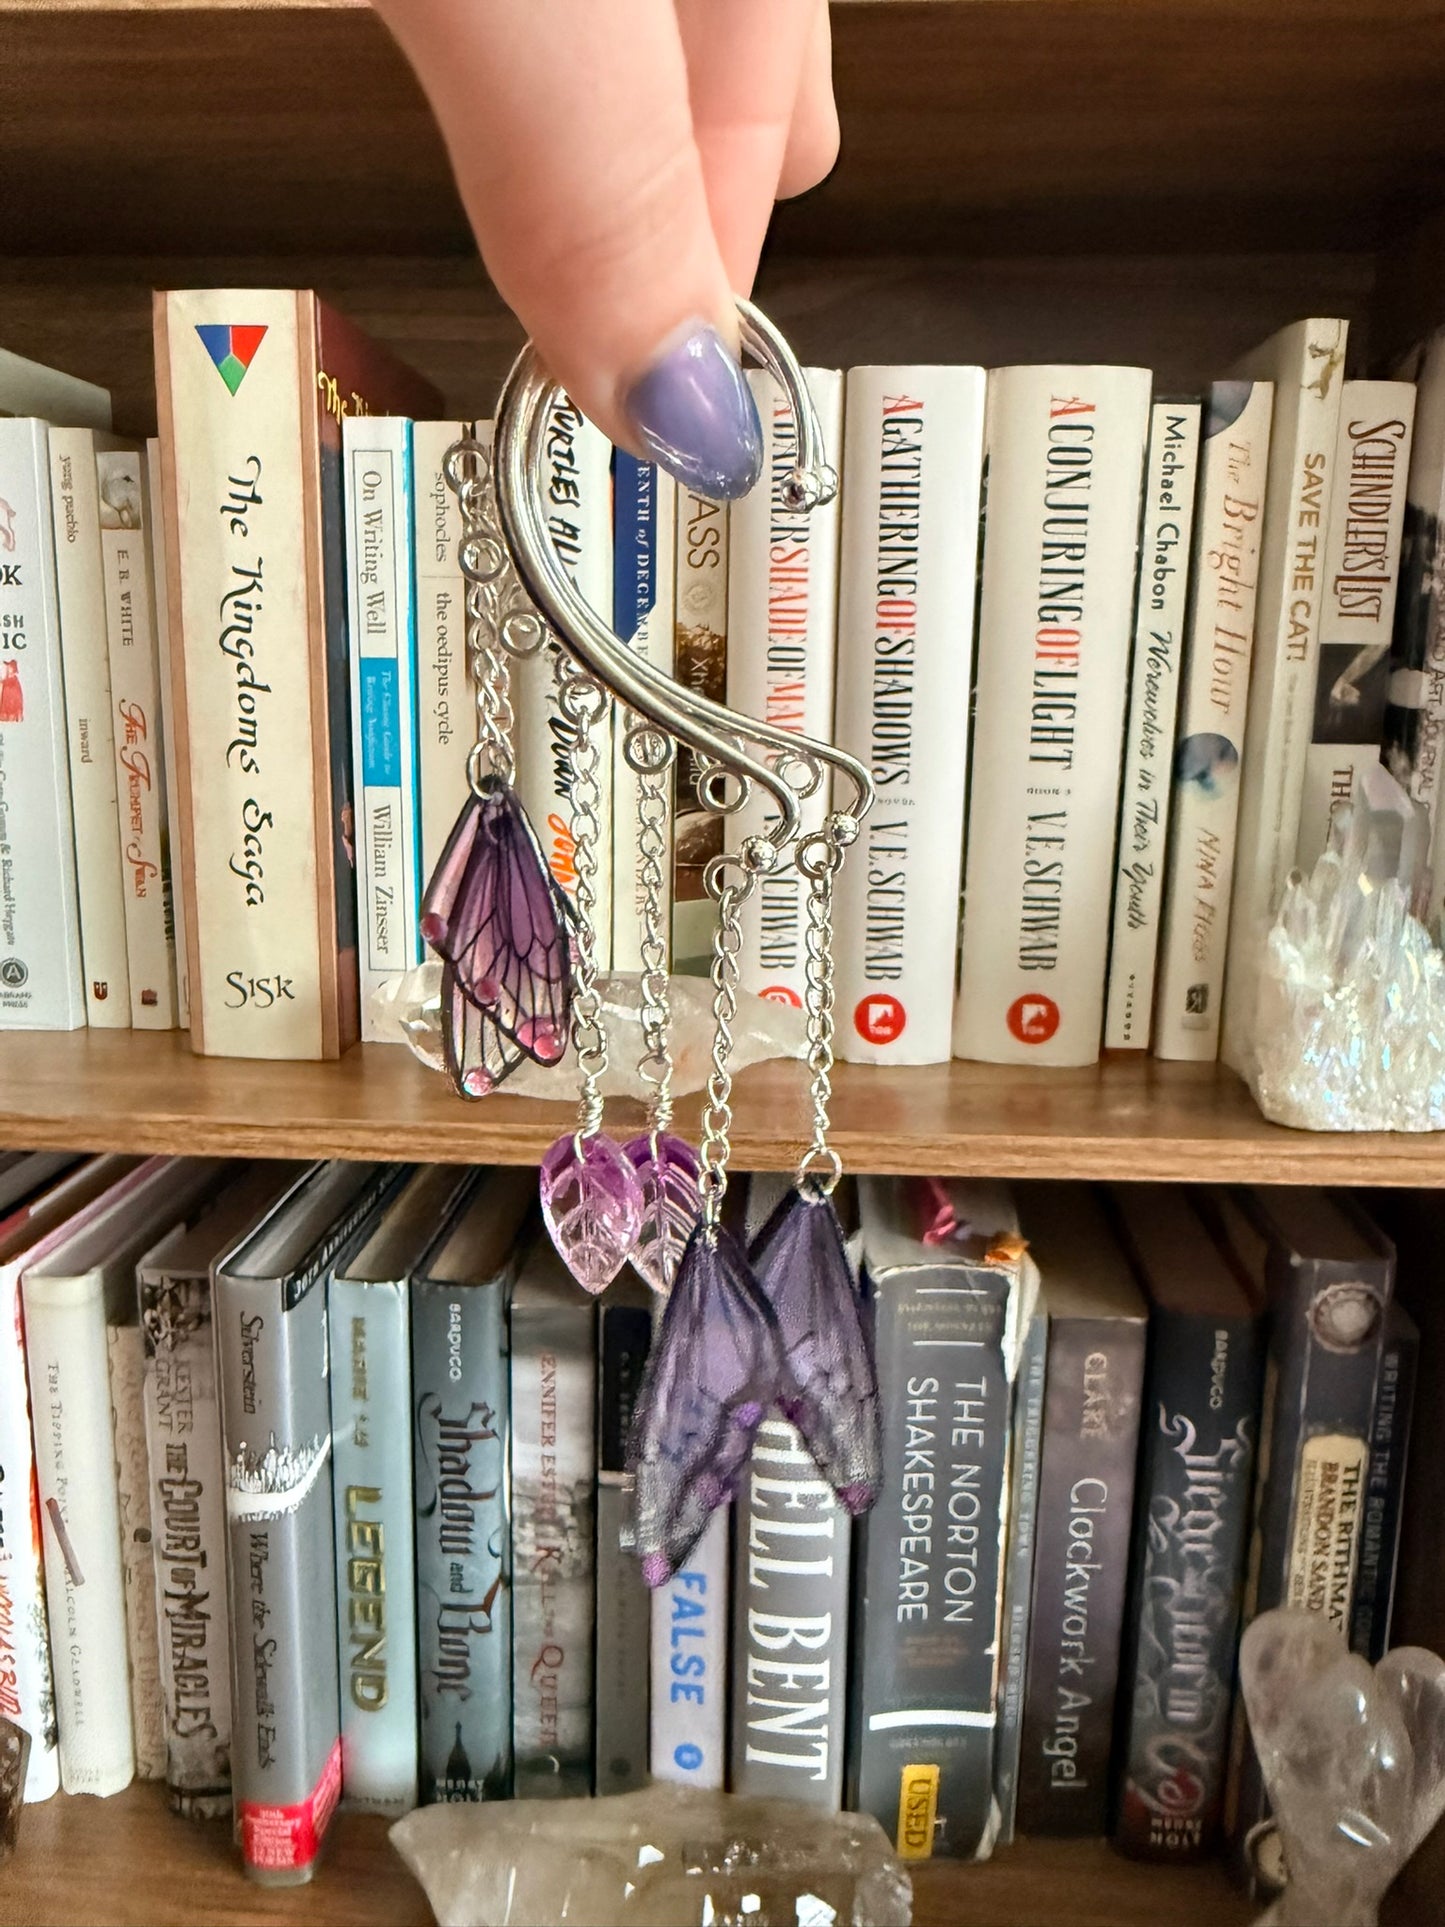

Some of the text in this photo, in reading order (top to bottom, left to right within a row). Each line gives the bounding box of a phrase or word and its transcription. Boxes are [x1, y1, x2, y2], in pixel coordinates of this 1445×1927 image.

[1049, 394, 1097, 418] A
[430, 472, 450, 563] sophocles
[686, 493, 721, 570] ASS
[1037, 423, 1096, 624] CONJURING
[1151, 415, 1187, 610] Michael Chabon
[1298, 453, 1326, 528] SAVE
[360, 470, 386, 635] On Writing Well
[636, 528, 649, 547] of
[1208, 493, 1259, 613] Bright
[1292, 536, 1317, 592] THE
[119, 592, 134, 647] WHITE
[636, 553, 650, 660] DECEMBE
[871, 394, 924, 786] A GATHERING OF SHADOWS
[1286, 599, 1312, 662] CAT!
[1335, 574, 1391, 623] LIST
[219, 455, 273, 907] The Kingdoms Saga
[433, 591, 453, 745] the oedipus cycle
[1035, 627, 1083, 668] OF
[1210, 624, 1247, 715] Hour
[78, 717, 93, 765] inward
[1029, 669, 1080, 771] LIGHT
[1139, 630, 1173, 764] Werewolves
[1129, 798, 1159, 852] Their
[1196, 826, 1221, 890] NINA
[373, 804, 394, 955] William Zinsser
[224, 971, 296, 1008] Sisk
[154, 1360, 175, 1436] GRANT
[240, 1310, 264, 1415] Silverstein
[1376, 1352, 1399, 1442] WRITING
[57, 1476, 70, 1525] POIN
[897, 1376, 940, 1623] SHAKESPEARE
[943, 1375, 987, 1623] THE NORTON
[1311, 1461, 1340, 1557] BRANDON
[1340, 1460, 1361, 1514] THE
[1369, 1450, 1390, 1488] THE
[159, 1477, 207, 1569] COURT
[249, 1531, 269, 1593] Where
[433, 1402, 497, 1702] Shadow and Bone
[346, 1485, 388, 1712] LEGEND
[669, 1571, 707, 1705] FALSE
[1042, 1477, 1108, 1788] Clockwork Angel
[164, 1585, 218, 1741] MIRACLES
[531, 1645, 565, 1747] QUEEN
[746, 1608, 832, 1781] BENT
[904, 1777, 932, 1848] USED
